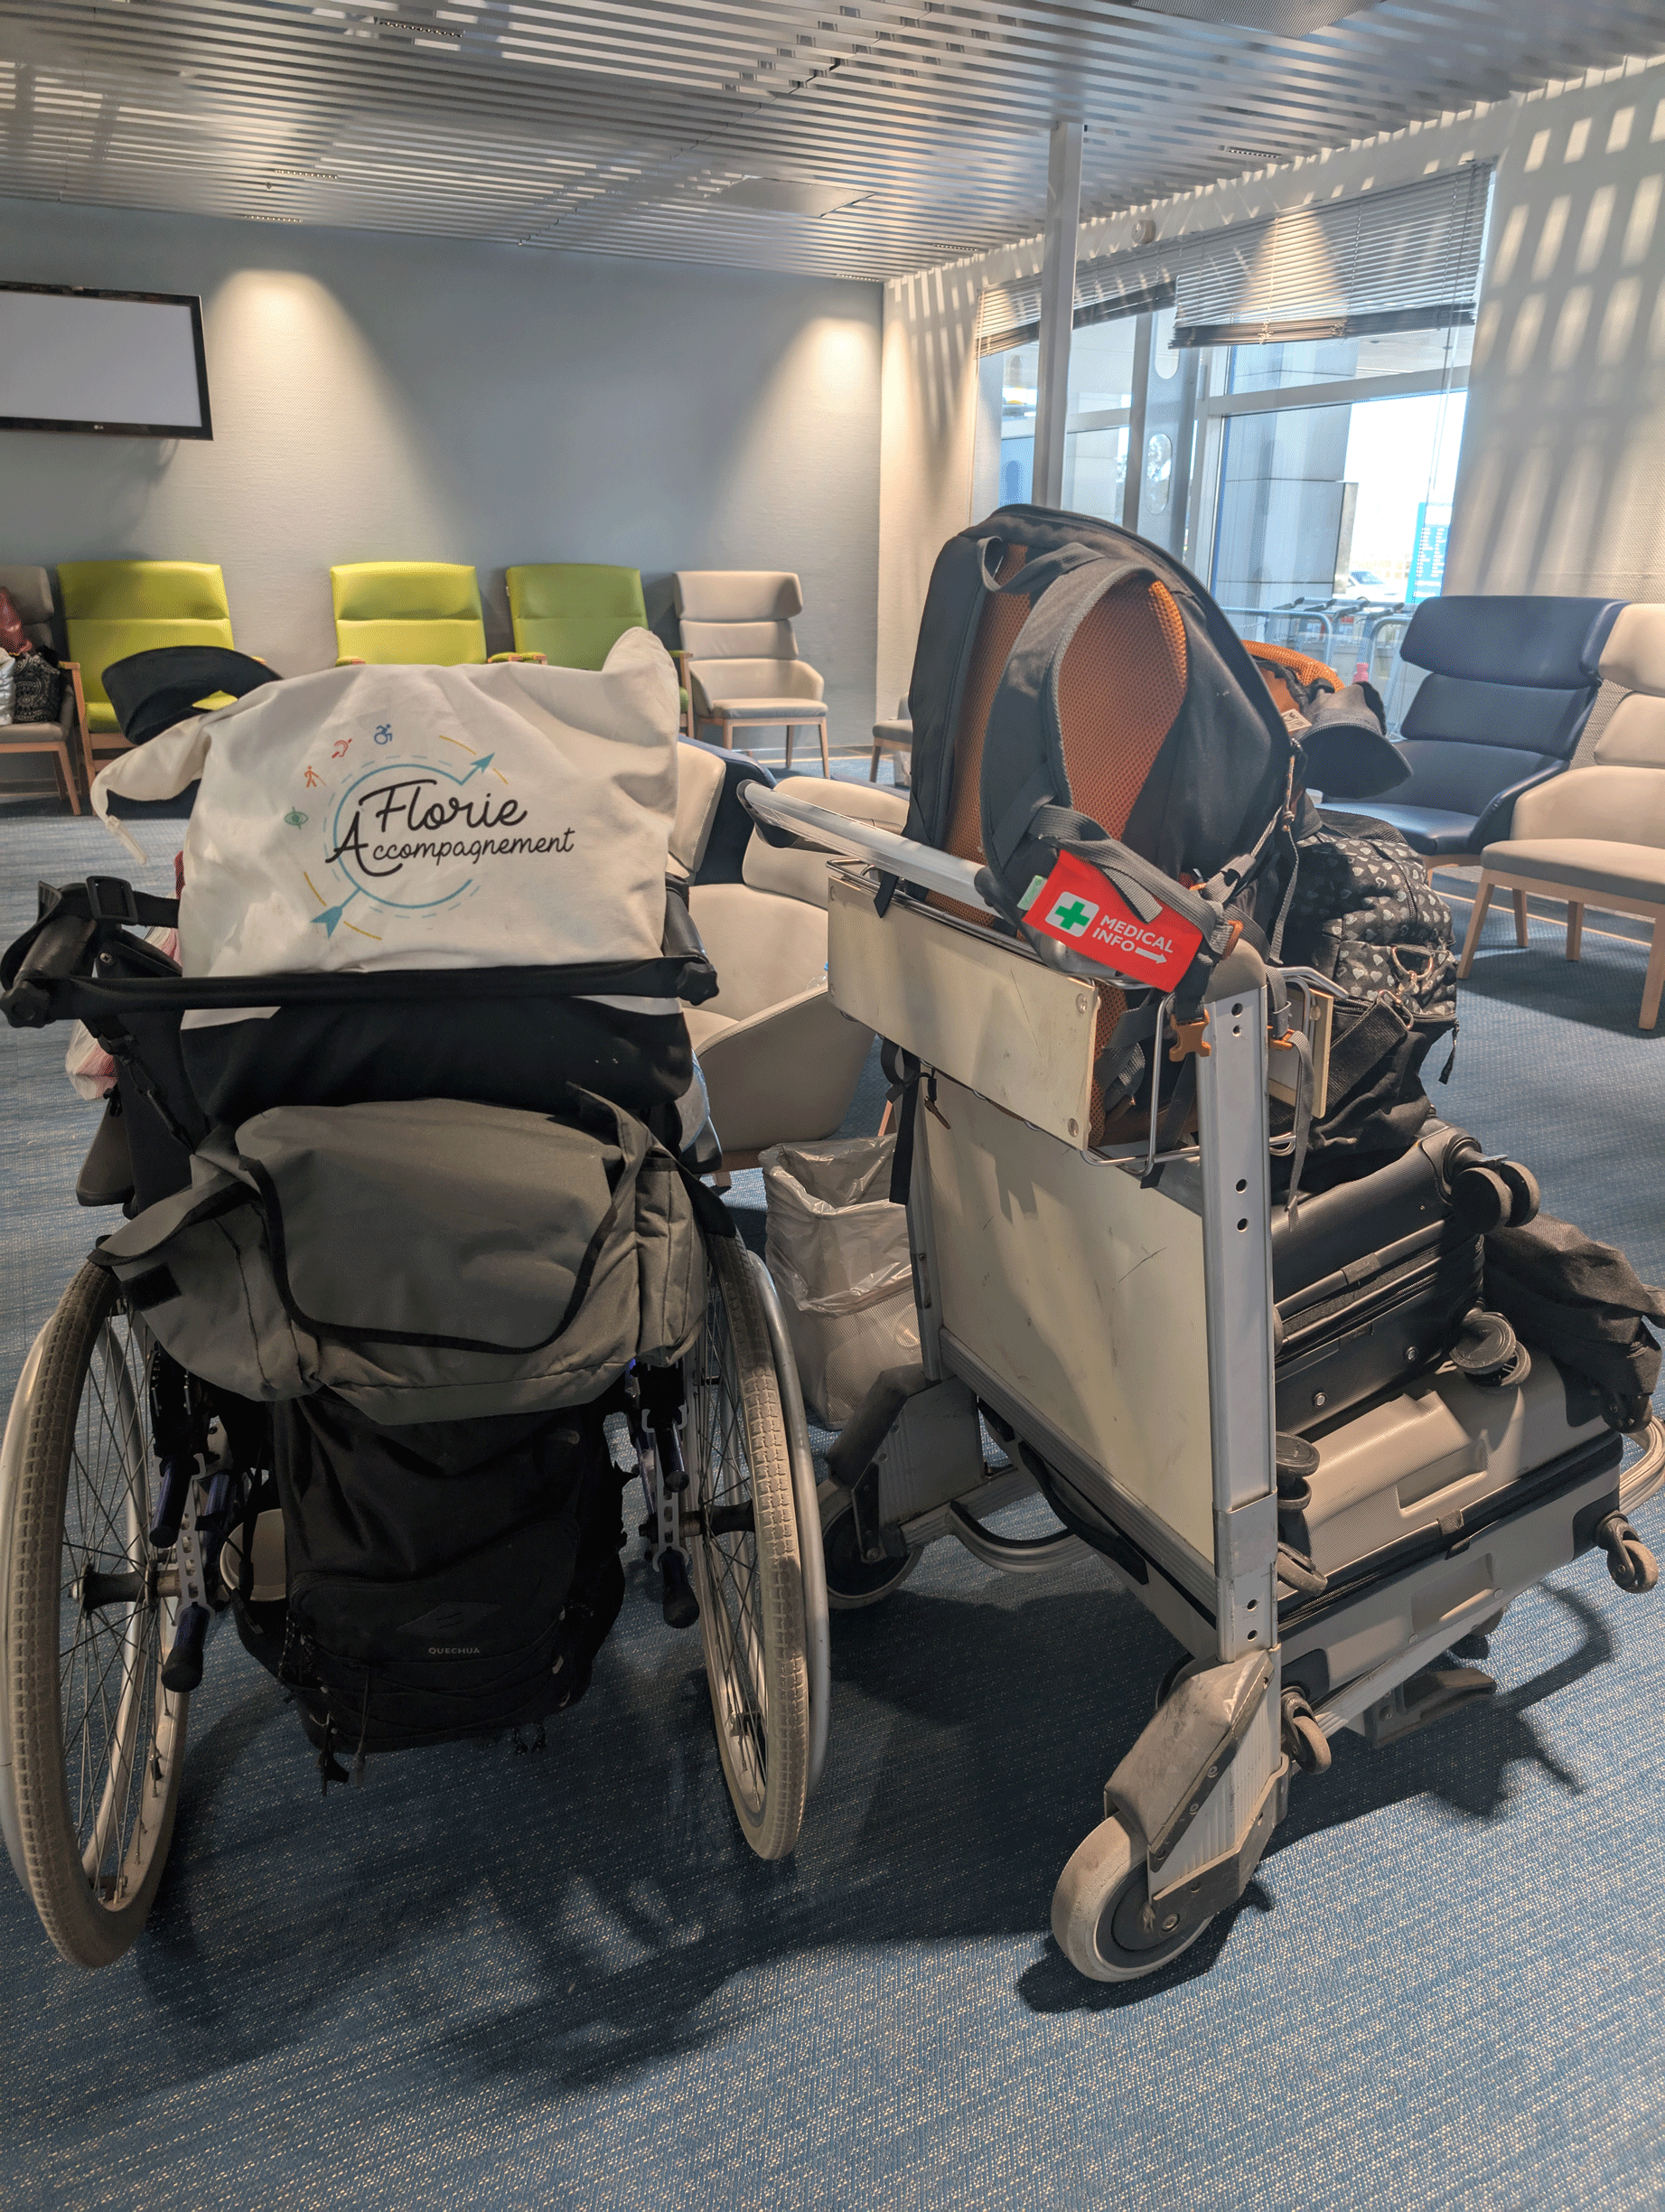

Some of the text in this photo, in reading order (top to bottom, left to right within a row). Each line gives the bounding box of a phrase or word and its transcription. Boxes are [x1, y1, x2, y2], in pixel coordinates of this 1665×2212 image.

[359, 780, 527, 832] Florie
[325, 811, 575, 876] Accompagnement
[1091, 927, 1136, 952] INFO
[1100, 914, 1174, 953] MEDICAL
[428, 1646, 481, 1655] QUECHUA
